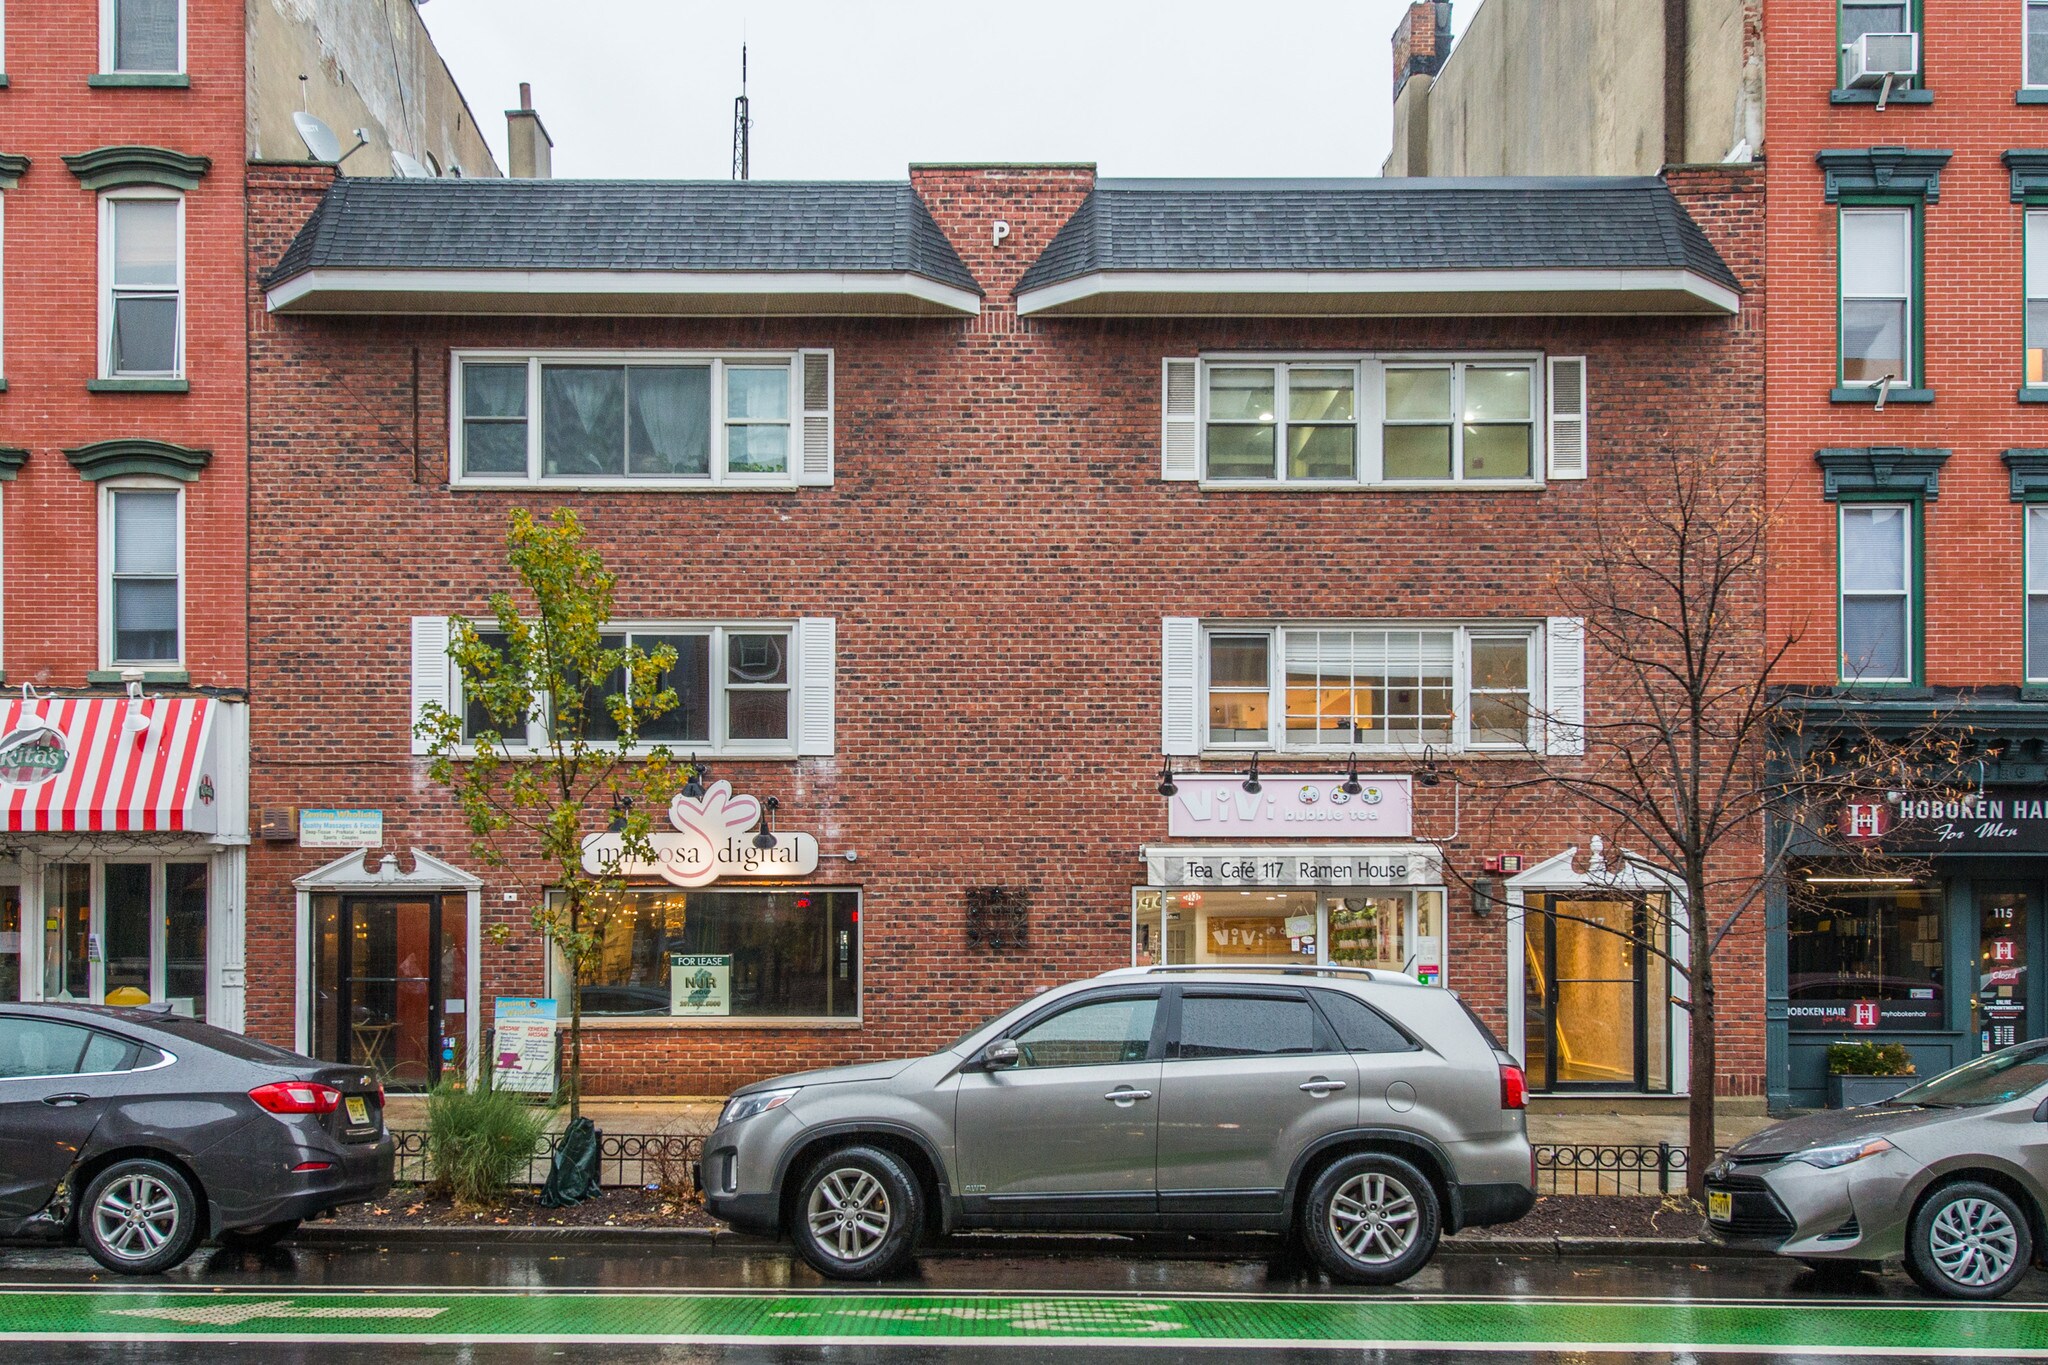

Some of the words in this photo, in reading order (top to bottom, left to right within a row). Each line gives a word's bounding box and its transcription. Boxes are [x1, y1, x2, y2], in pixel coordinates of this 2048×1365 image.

[993, 220, 1010, 247] P
[1179, 787, 1276, 821] ViVi
[1900, 800, 2003, 819] HOBOKEN
[1285, 807, 1343, 821] bubble
[1349, 808, 1378, 821] tea
[1933, 823, 1965, 842] For
[1974, 822, 2018, 838] Men
[717, 836, 800, 872] digital
[1187, 862, 1213, 878] Tea
[1220, 861, 1255, 878] Café
[1262, 862, 1284, 878] 117
[1300, 862, 1352, 878] Ramen
[1358, 862, 1406, 878] House
[1994, 908, 2013, 919] 115
[1212, 928, 1263, 946] ViVi
[678, 957, 695, 966] FOR
[698, 957, 723, 966] LEASE
[1826, 1007, 1846, 1016] HAIR
[965, 1184, 987, 1192] AWD
